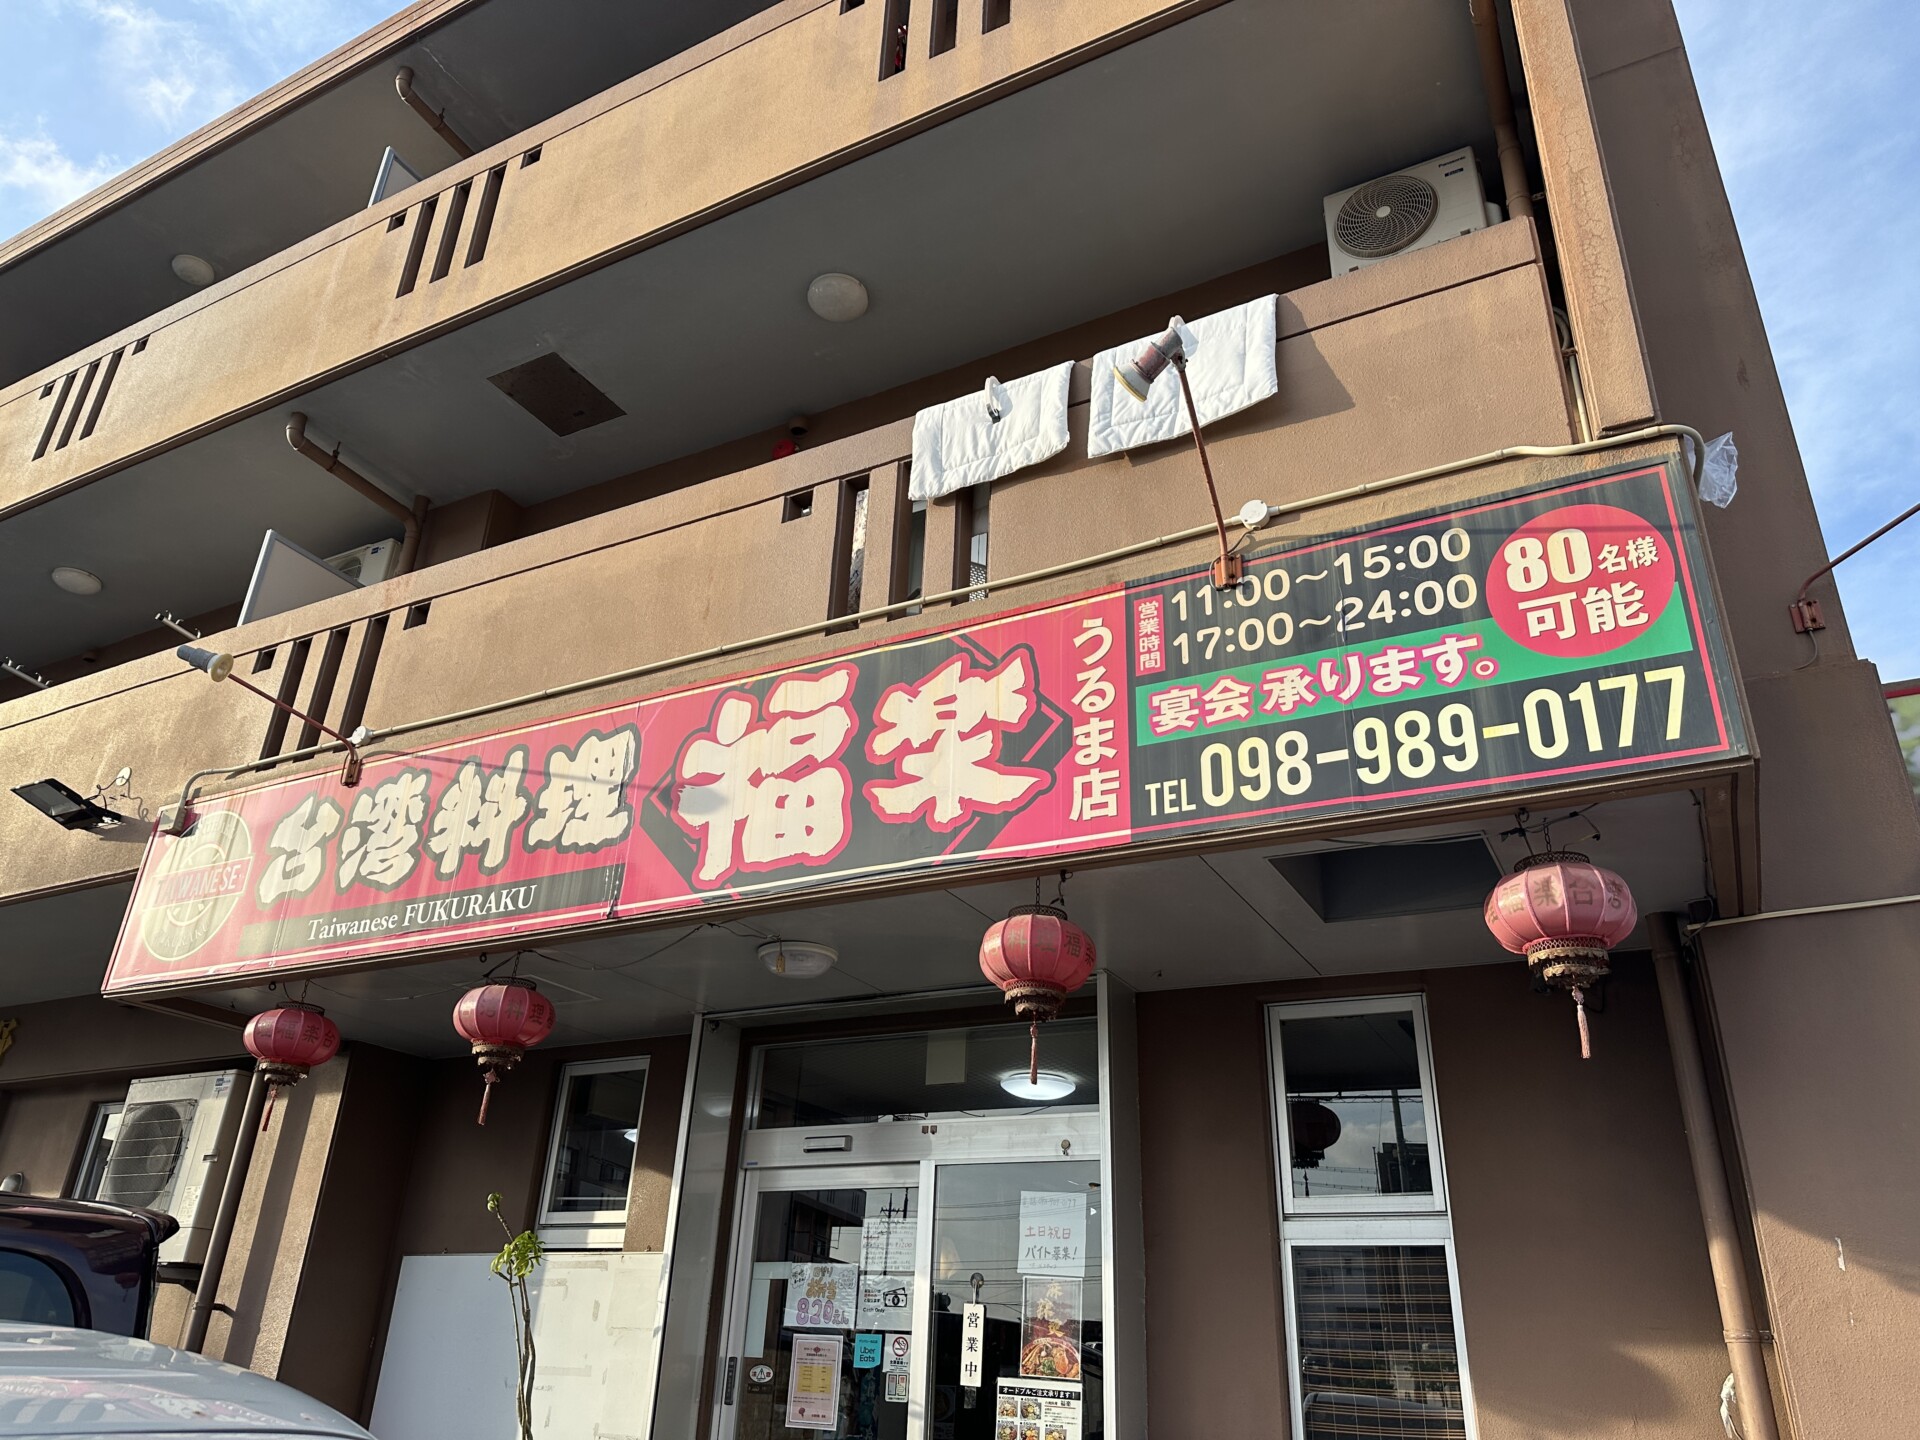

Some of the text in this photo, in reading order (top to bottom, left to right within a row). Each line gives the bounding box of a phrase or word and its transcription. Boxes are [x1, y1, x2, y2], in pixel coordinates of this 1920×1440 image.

[1137, 600, 1162, 670] 営業時間
[1517, 582, 1650, 641] 可能
[1069, 617, 1121, 822] うるま店
[1145, 666, 1687, 816] TEL 098-989-0177
[677, 657, 1047, 882] 福楽
[259, 728, 636, 904] 台湾料理
[156, 864, 242, 904] TAIWANESE
[308, 884, 538, 941] Taiwanese FUKURAKU
[1024, 1225, 1071, 1239] 土日祝日
[860, 1346, 875, 1354] Uber
[965, 1312, 980, 1377] 営業中
